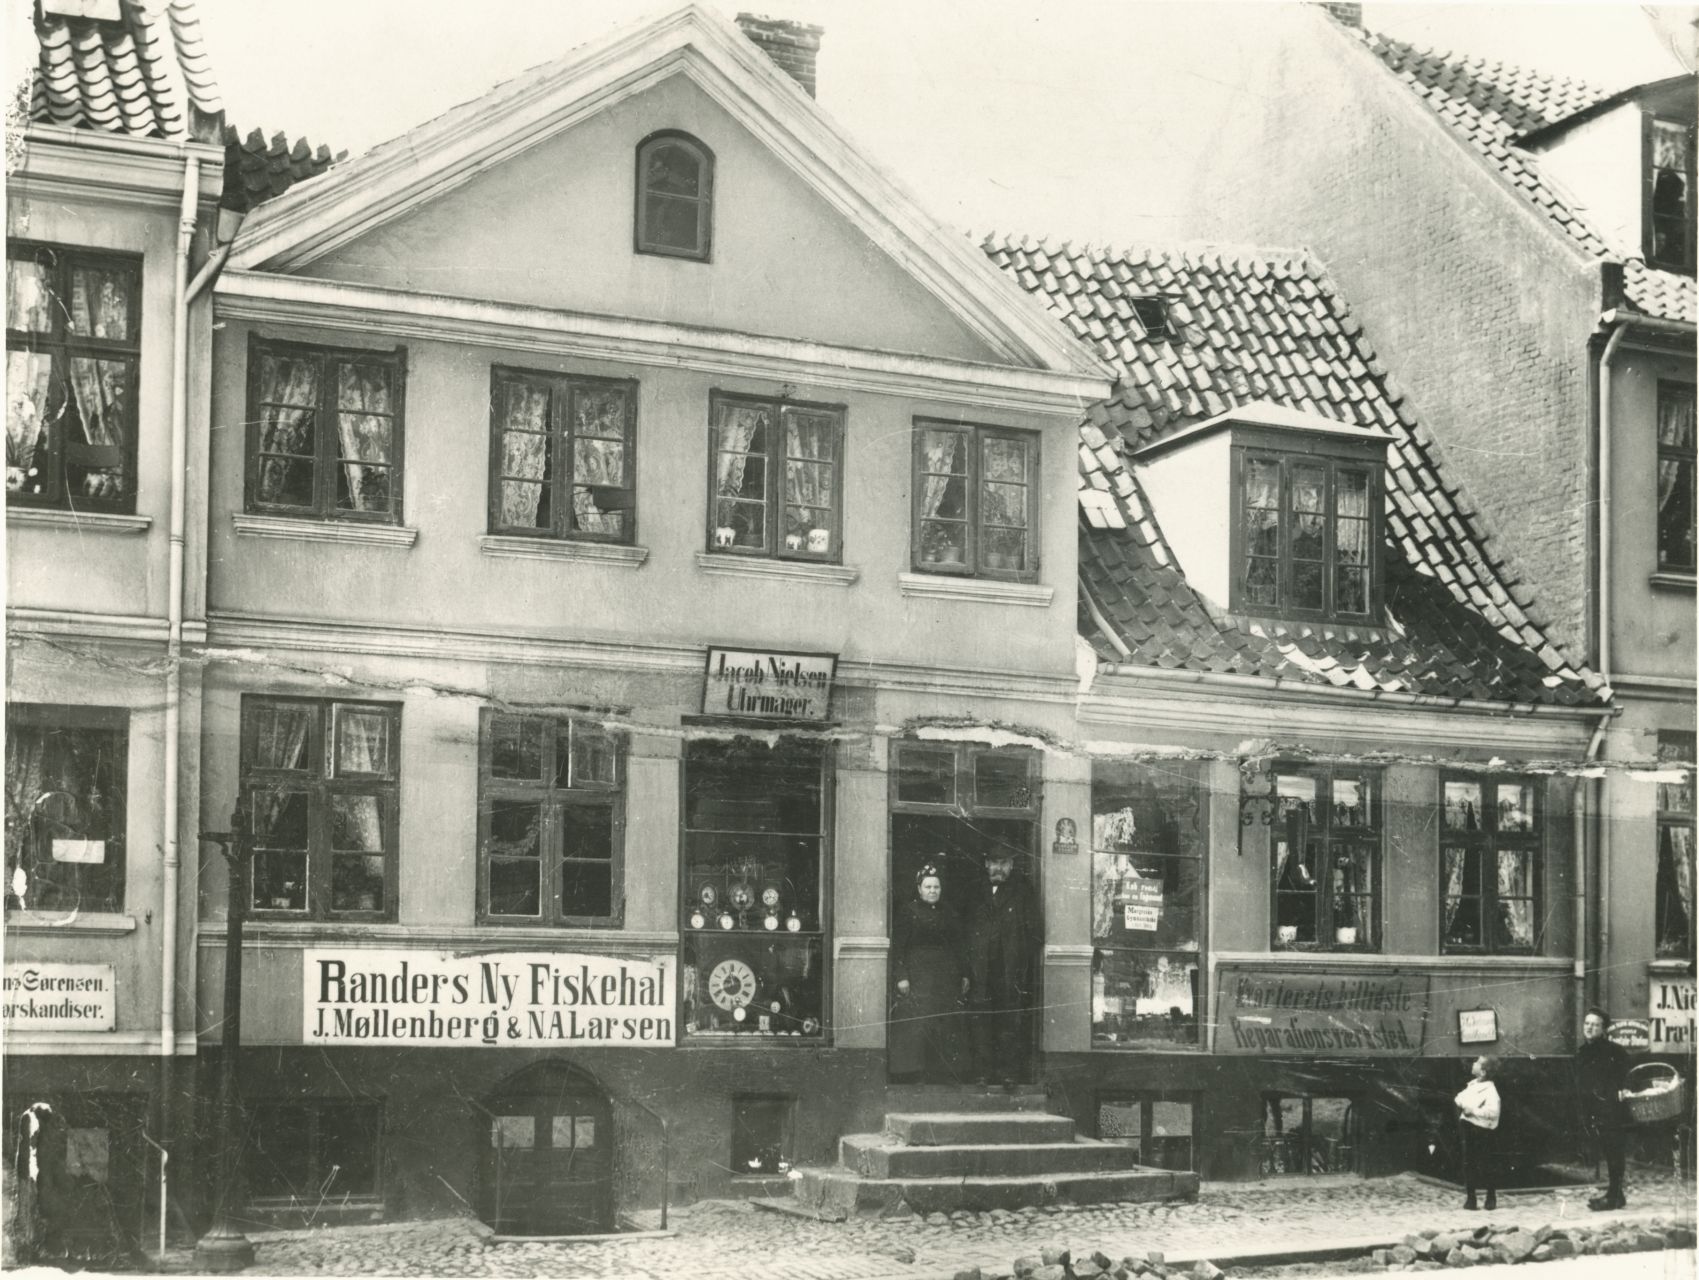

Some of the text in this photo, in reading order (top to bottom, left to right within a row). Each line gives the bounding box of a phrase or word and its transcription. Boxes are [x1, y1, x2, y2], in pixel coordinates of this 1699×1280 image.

[718, 653, 828, 689] Jacob Nielsen
[727, 685, 815, 716] Uhrmager.
[22, 969, 109, 992] Sørensen.
[315, 958, 666, 1012] Randers Ny Fiskehal
[506, 1016, 523, 1040] &
